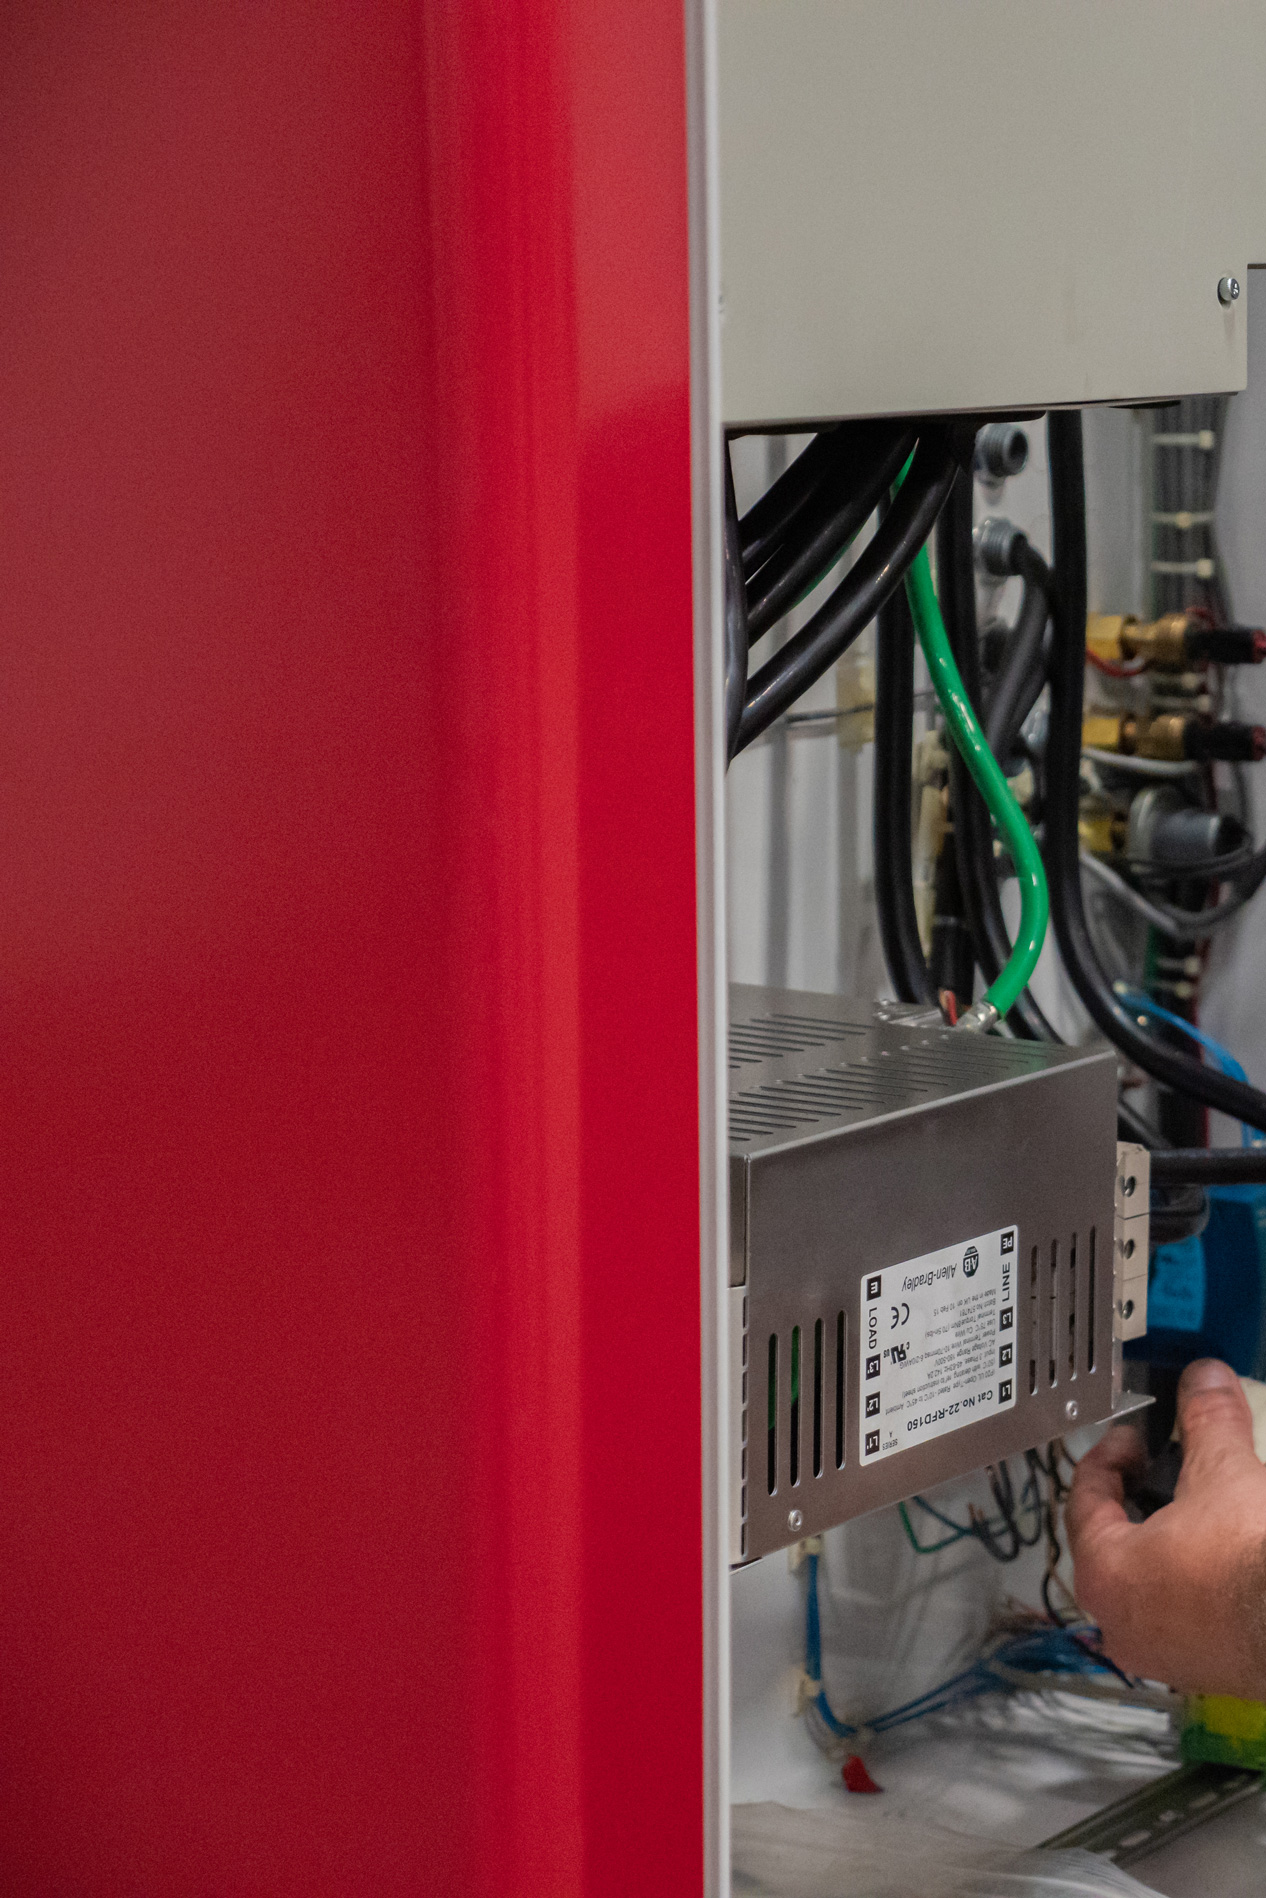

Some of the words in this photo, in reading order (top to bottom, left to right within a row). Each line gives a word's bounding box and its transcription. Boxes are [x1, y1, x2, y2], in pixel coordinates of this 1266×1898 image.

[1002, 1236, 1013, 1249] PE
[902, 1263, 957, 1291] Allen-Bradley
[1002, 1263, 1010, 1302] LINE
[1003, 1312, 1011, 1324] L3
[869, 1307, 877, 1349] LOAD
[1002, 1348, 1011, 1360] L2
[978, 1390, 993, 1403] Cat
[1002, 1385, 1010, 1396] L1
[883, 1438, 898, 1450] SERIES
